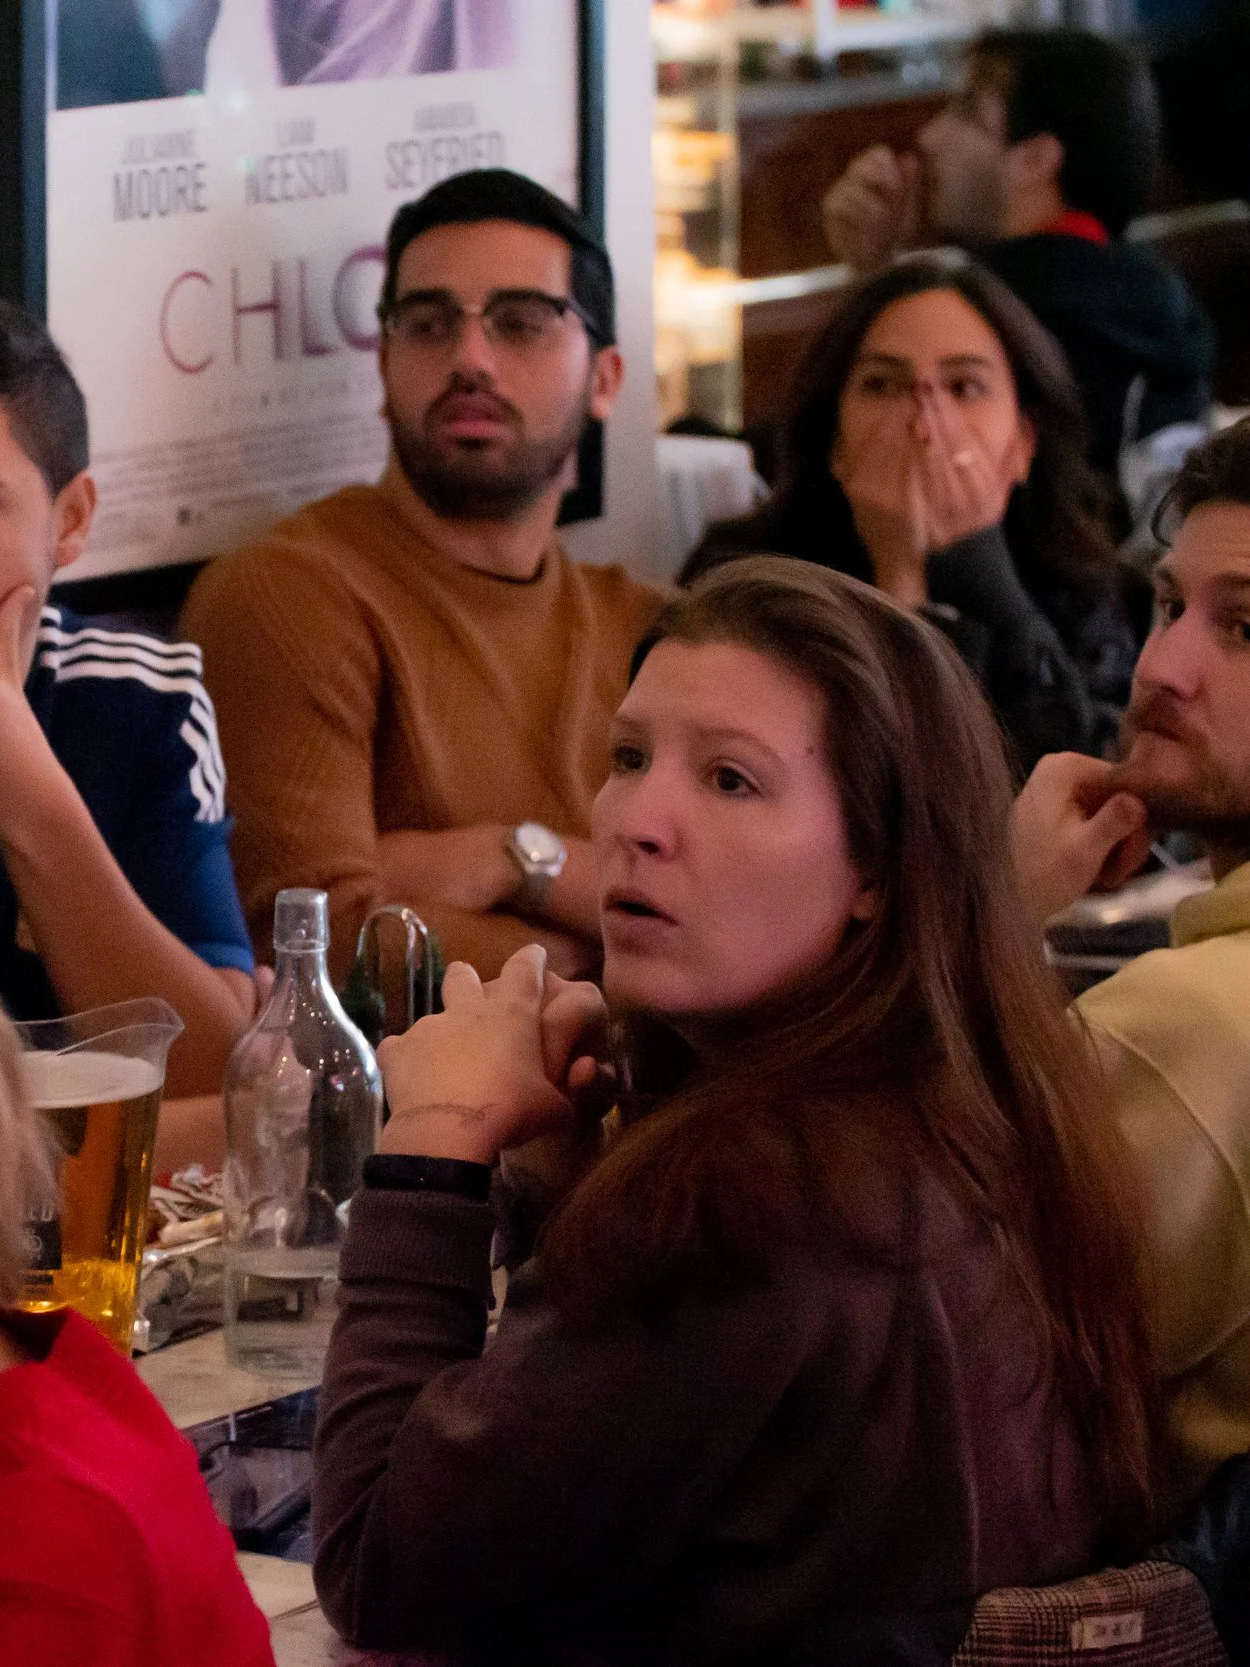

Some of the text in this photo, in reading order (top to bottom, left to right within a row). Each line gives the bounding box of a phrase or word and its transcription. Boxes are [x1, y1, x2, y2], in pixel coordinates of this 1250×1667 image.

[112, 161, 208, 222] MOORE
[245, 147, 349, 207] NEESON
[159, 244, 387, 375] CHLO
